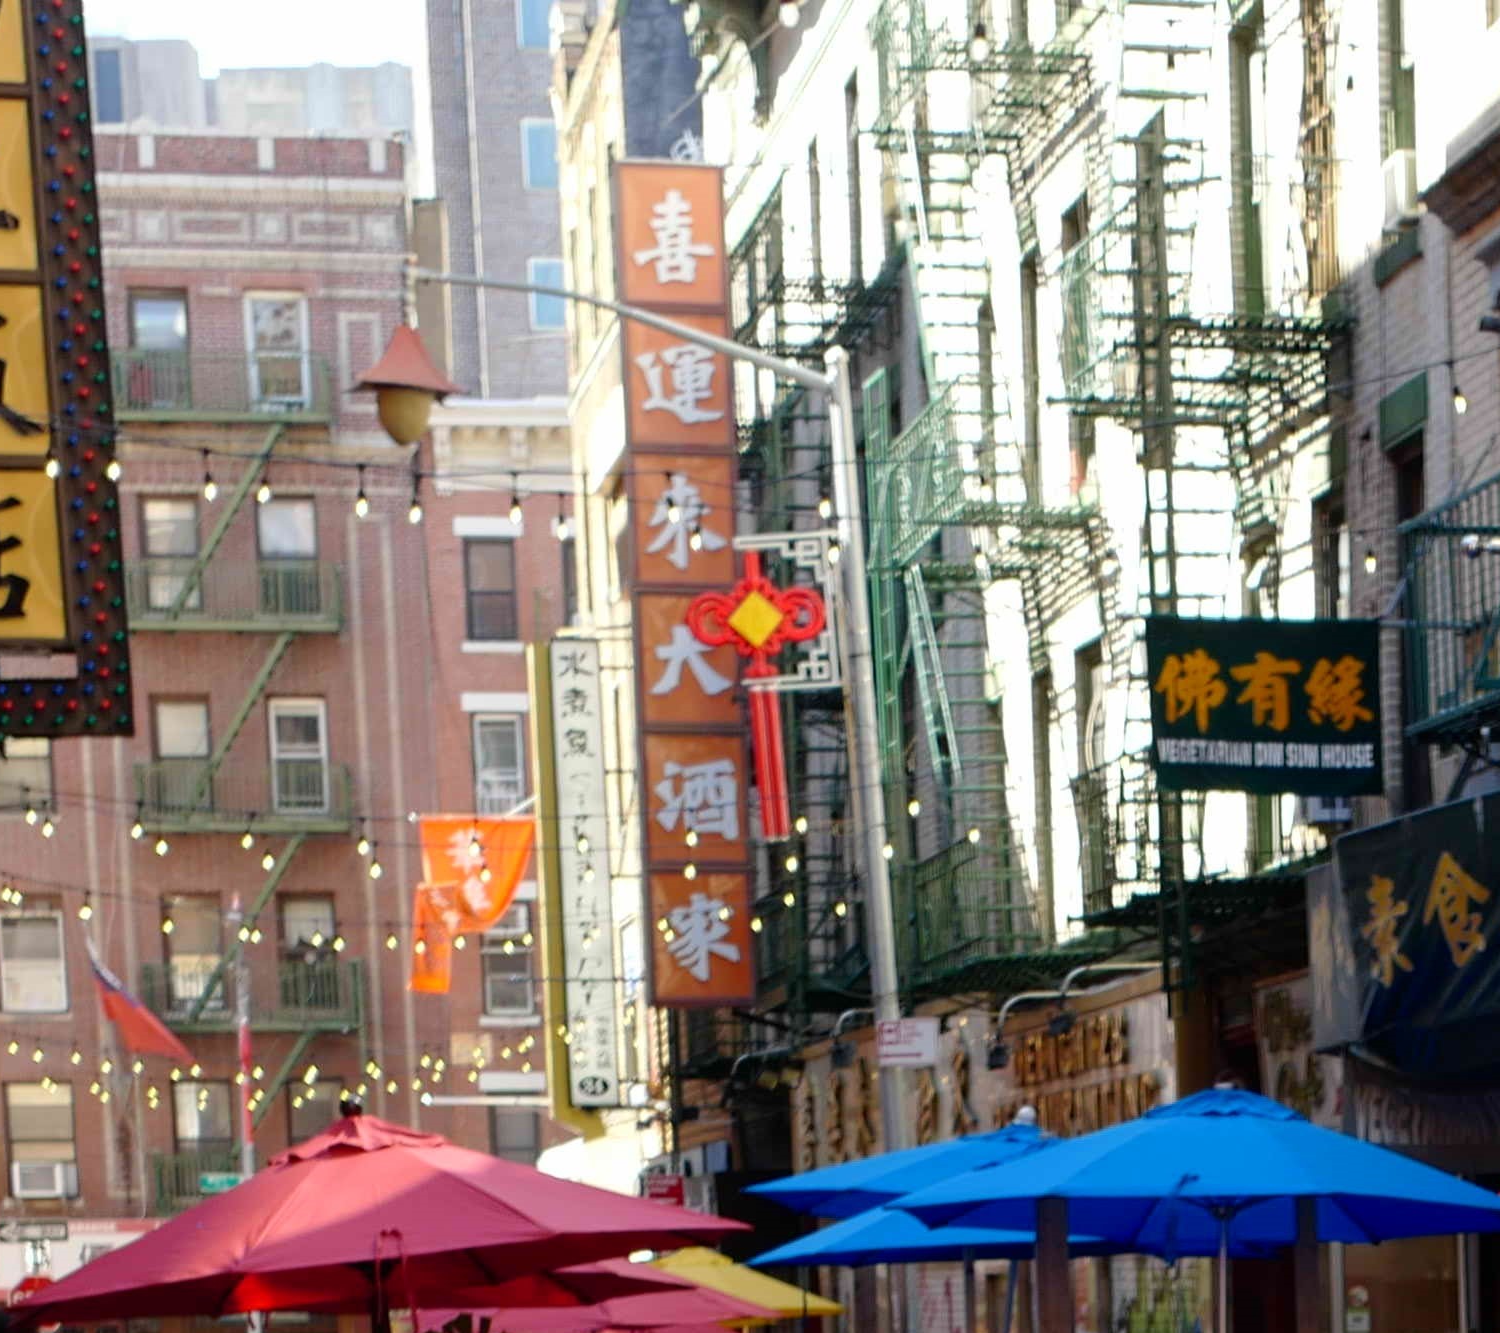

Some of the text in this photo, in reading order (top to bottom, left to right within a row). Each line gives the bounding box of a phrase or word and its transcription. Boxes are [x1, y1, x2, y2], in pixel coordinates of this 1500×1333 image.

[634, 188, 743, 984] 喜運來大酒家
[1154, 648, 1374, 734] 佛有緣
[1156, 737, 1253, 767] VEGETARIAN
[1321, 743, 1376, 769] HOUSE
